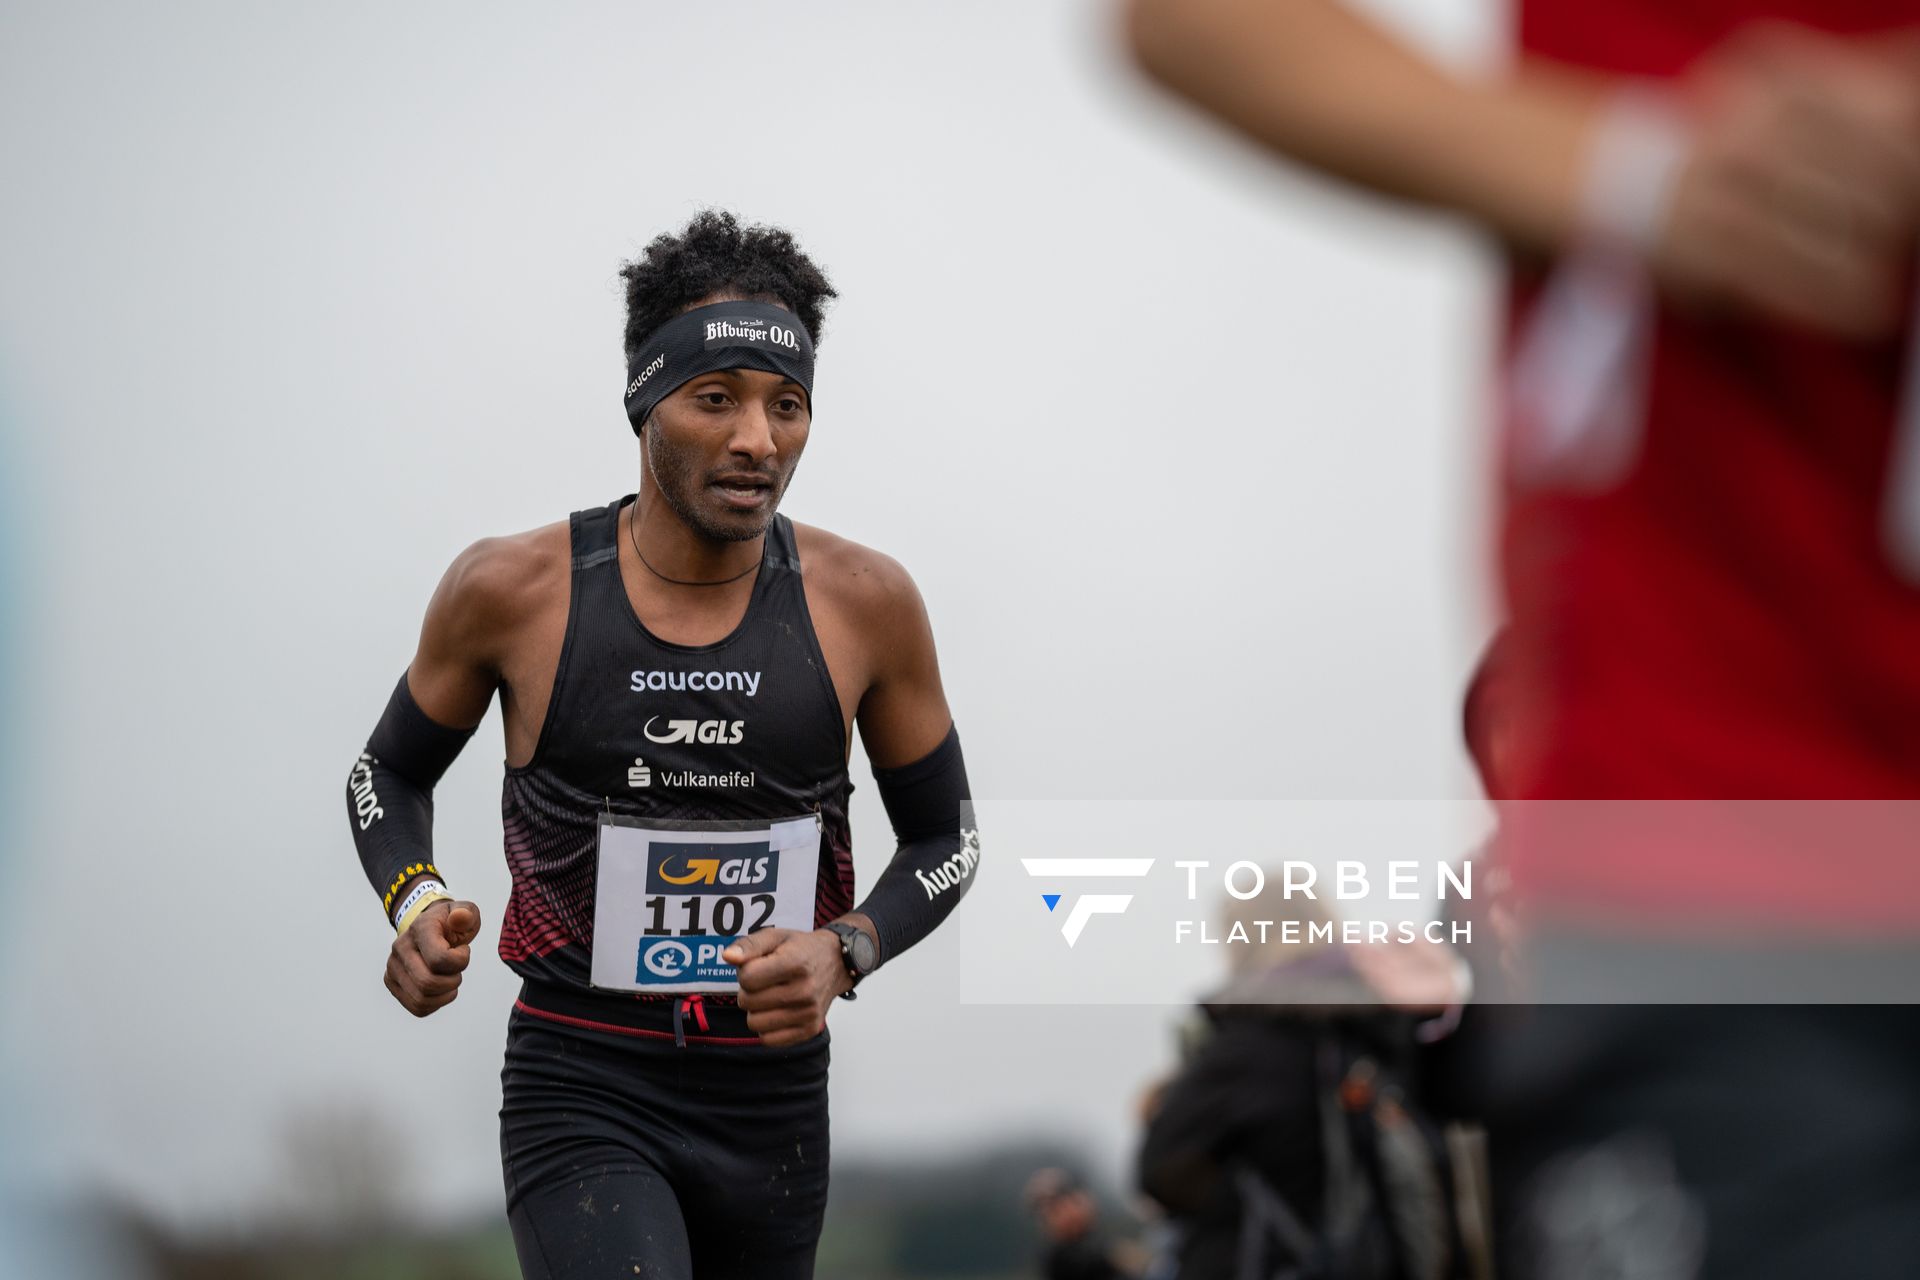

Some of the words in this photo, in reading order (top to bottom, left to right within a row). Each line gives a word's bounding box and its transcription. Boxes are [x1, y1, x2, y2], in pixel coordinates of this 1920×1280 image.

[706, 320, 768, 342] Bitburger
[627, 353, 665, 398] saucony
[630, 670, 762, 697] saucony
[697, 719, 745, 745] GLS
[660, 770, 755, 788] Vulkaneifel
[718, 856, 769, 886] GLS
[643, 894, 776, 937] 1102
[697, 943, 729, 966] PL
[696, 967, 737, 977] INTERNA
